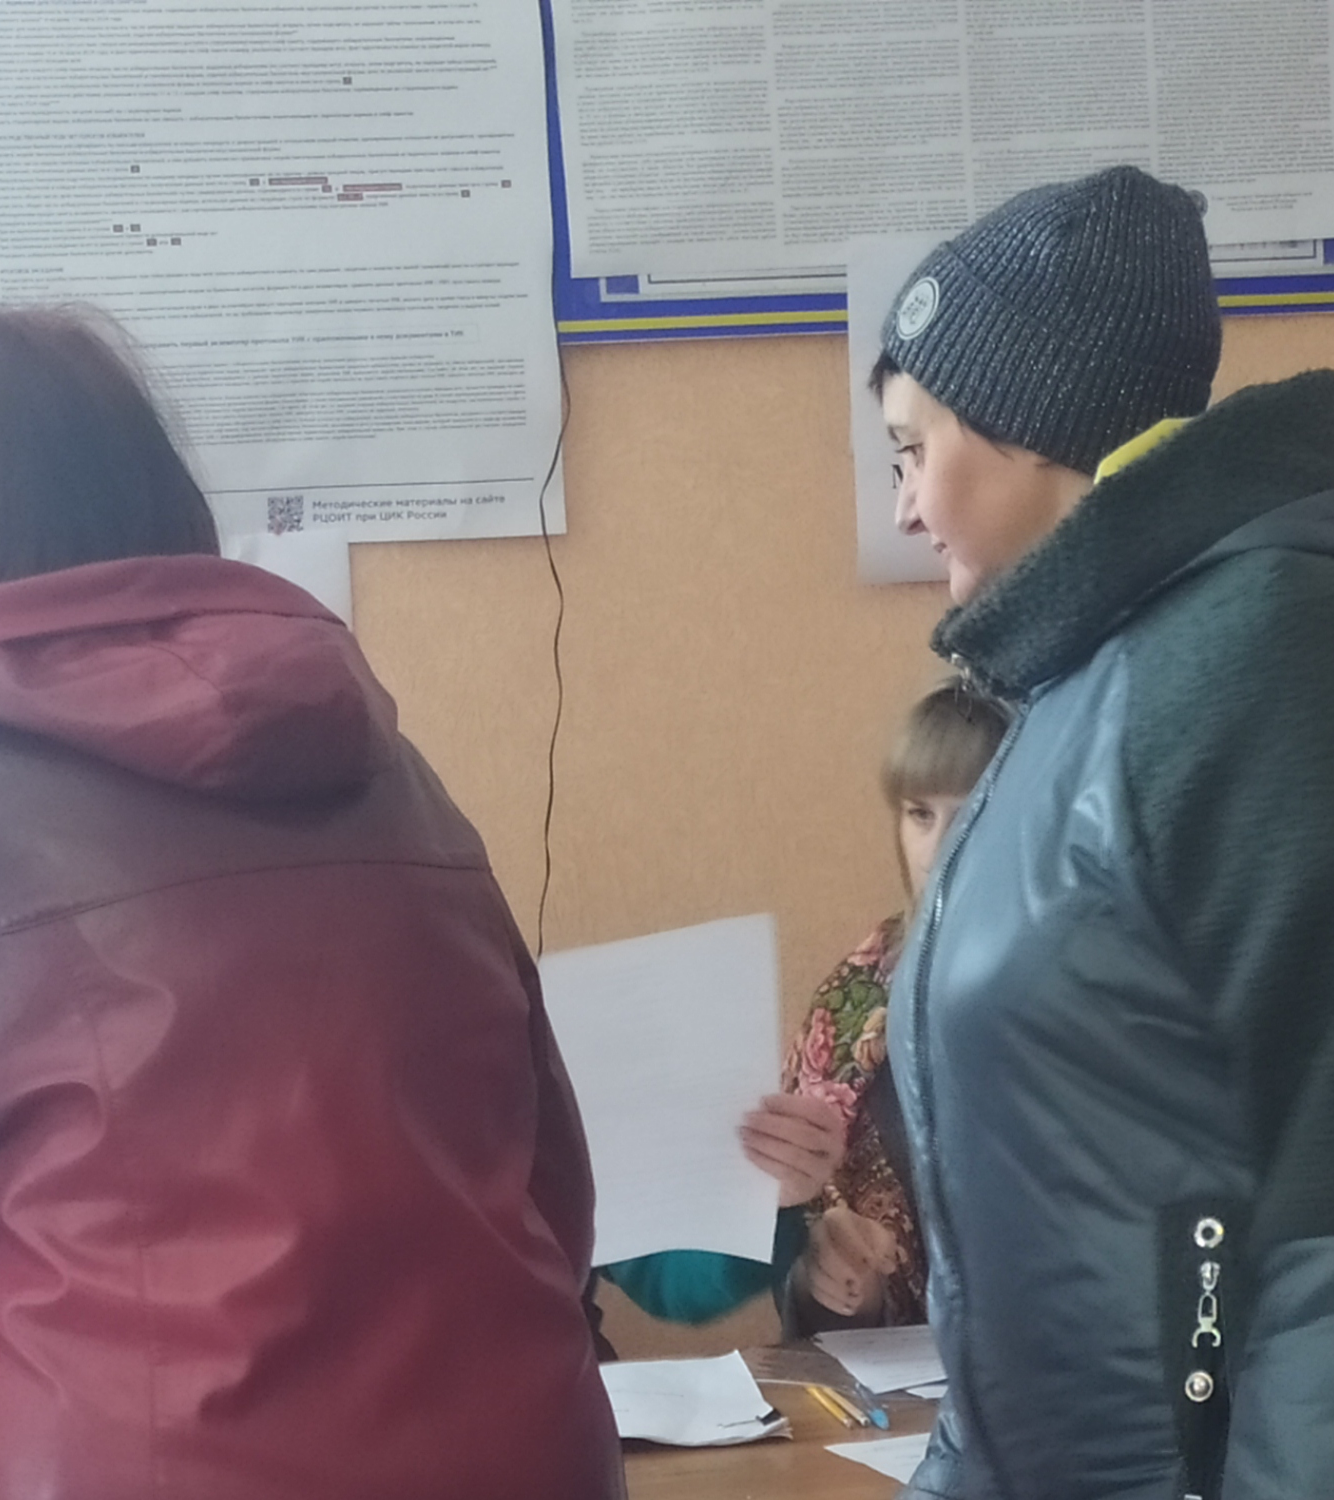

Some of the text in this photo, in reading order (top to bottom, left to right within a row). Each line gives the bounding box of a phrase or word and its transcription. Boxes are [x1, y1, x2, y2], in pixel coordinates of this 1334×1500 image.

[312, 499, 393, 511] Методические
[395, 497, 457, 509] материалы
[460, 496, 473, 505] на
[313, 510, 447, 524] РЦОИТ при ЦИК России
